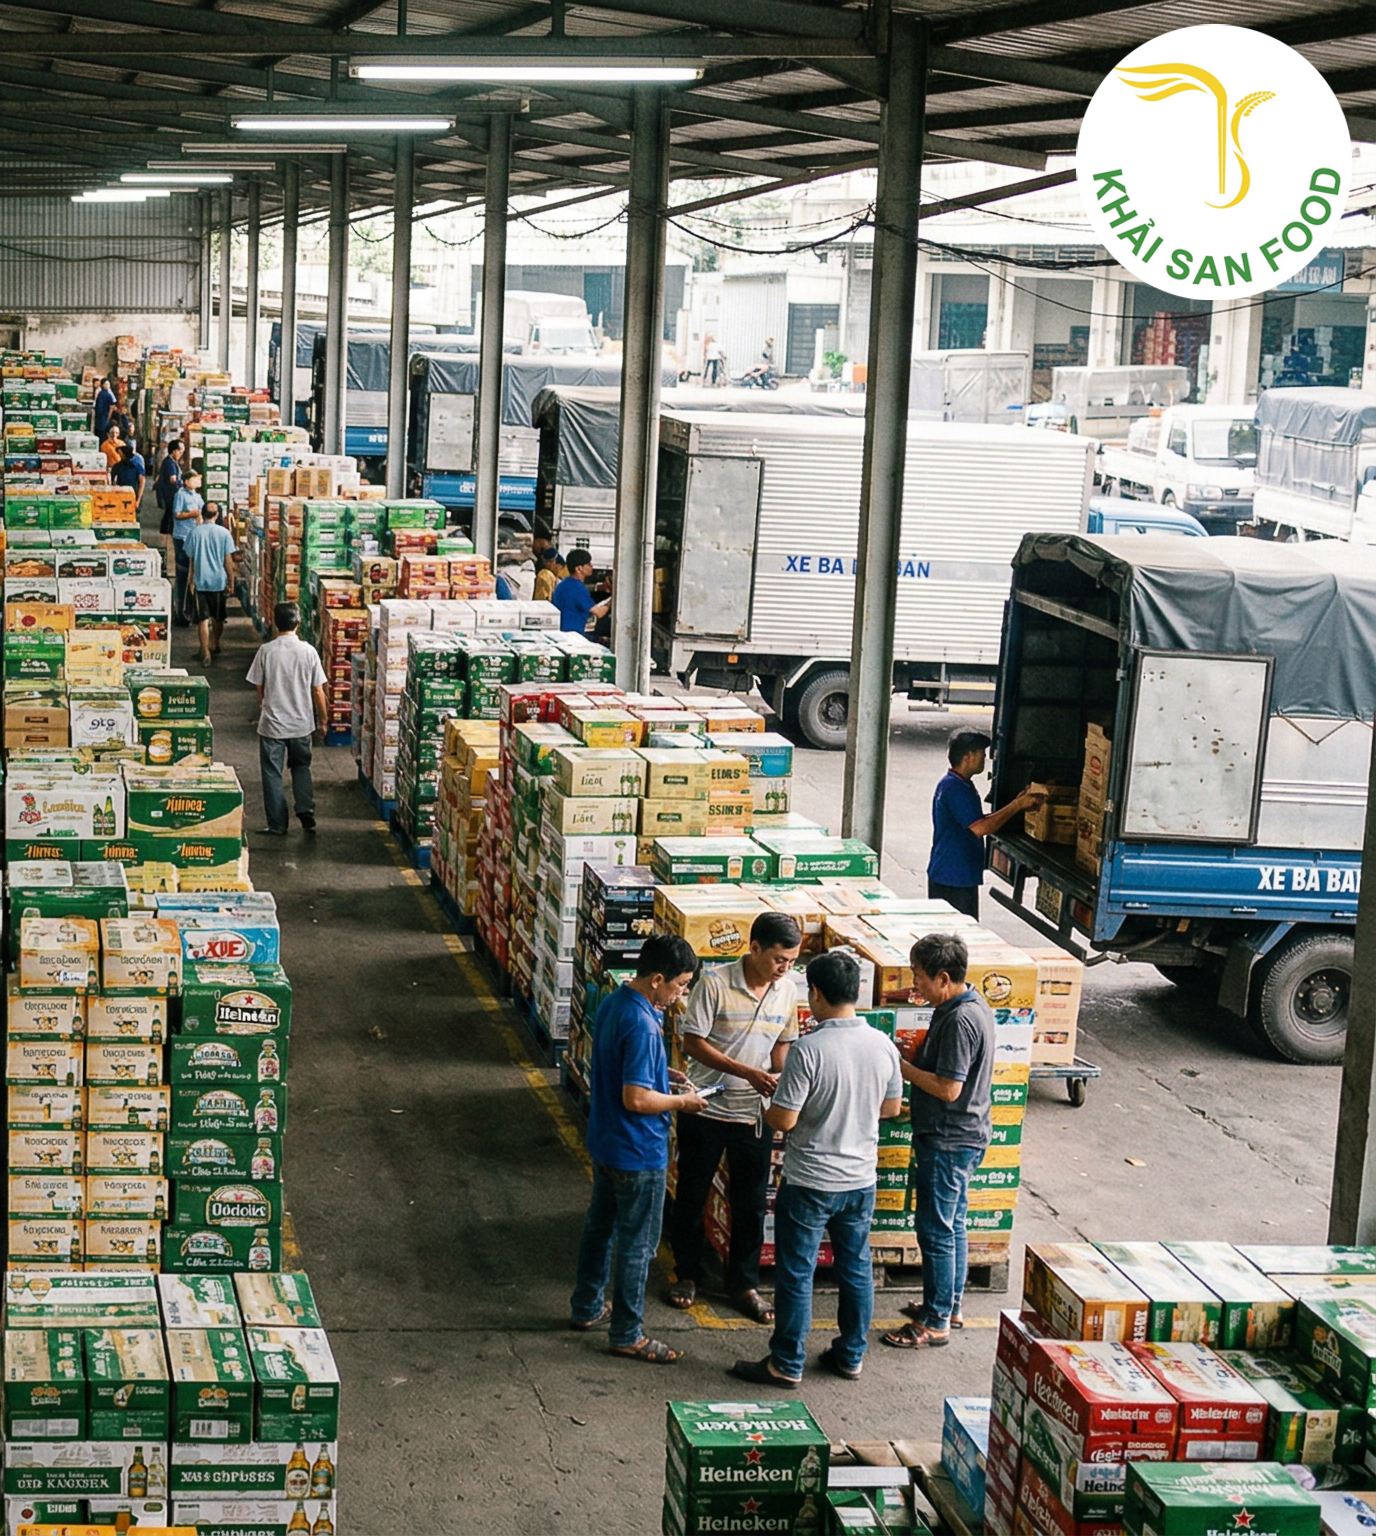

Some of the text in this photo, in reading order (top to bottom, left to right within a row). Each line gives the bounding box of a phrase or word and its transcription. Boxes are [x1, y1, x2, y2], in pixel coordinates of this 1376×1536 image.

[785, 555, 811, 573] XE
[818, 557, 844, 575] BA
[1257, 866, 1286, 890] XE
[1291, 867, 1321, 892] BA
[699, 1466, 794, 1483] Heineken
[697, 1515, 789, 1532] Heineken
